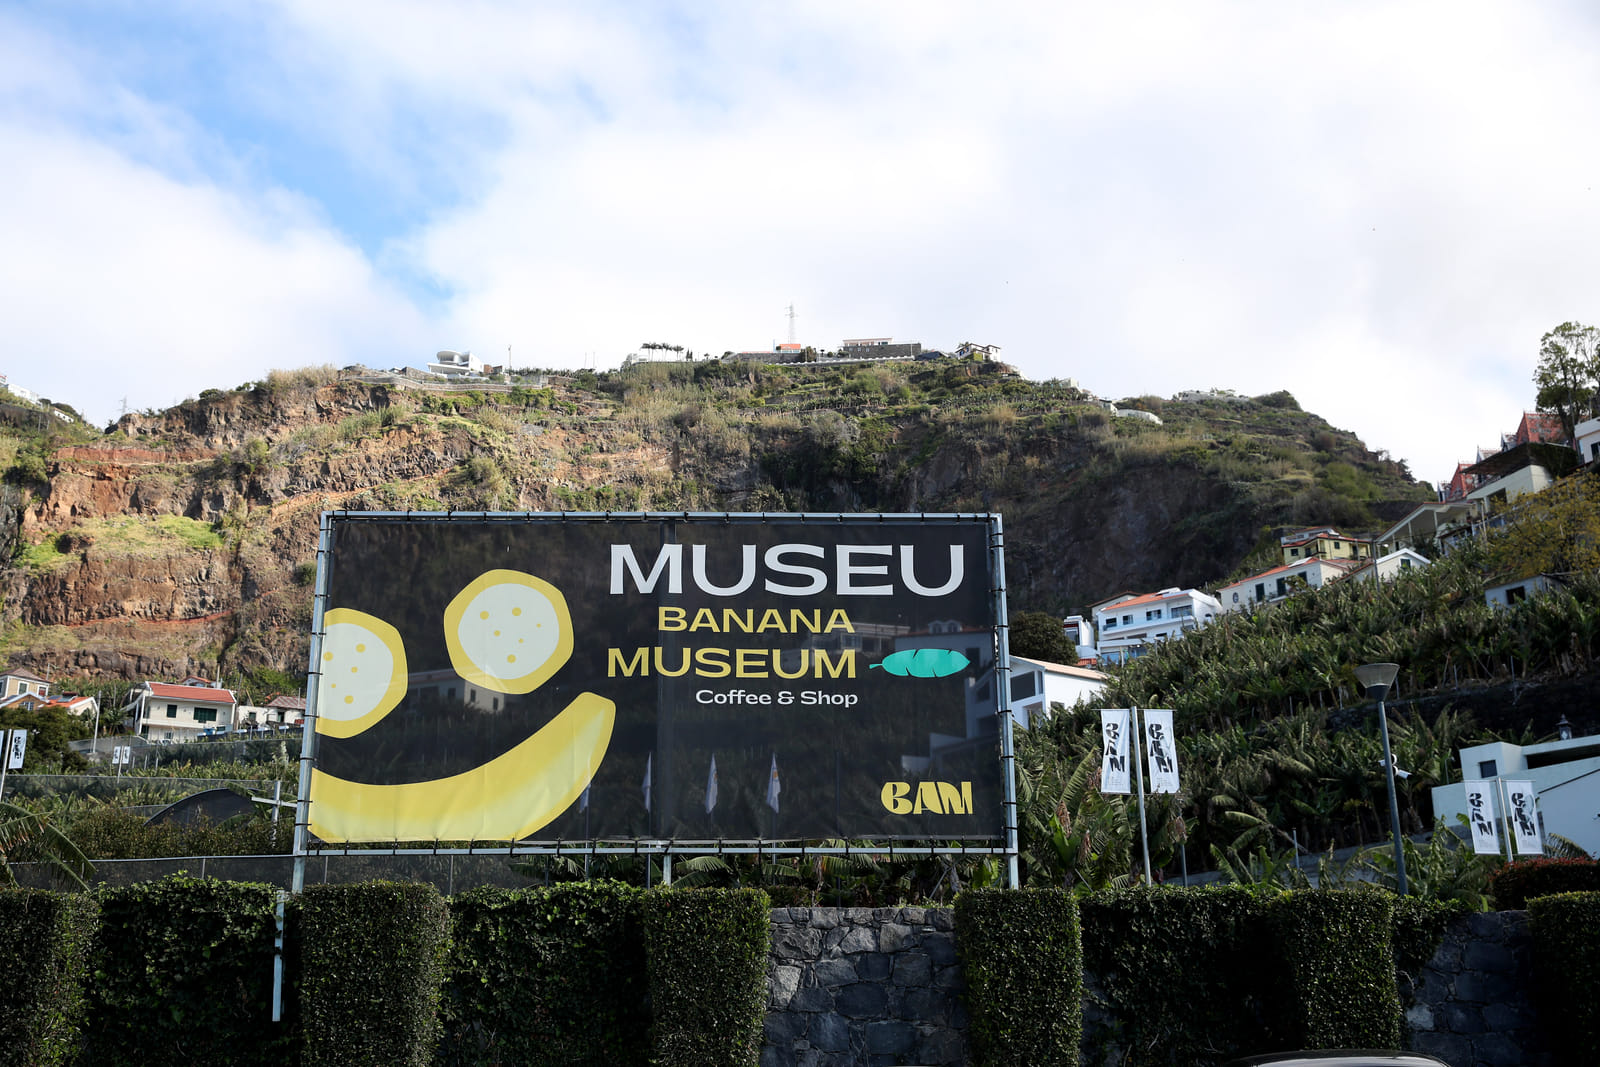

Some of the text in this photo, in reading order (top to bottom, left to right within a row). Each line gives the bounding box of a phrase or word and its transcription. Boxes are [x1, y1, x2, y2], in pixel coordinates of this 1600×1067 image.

[609, 543, 965, 597] MUSEU
[658, 606, 856, 634] BANANA
[607, 646, 856, 679] MUSEUM
[695, 689, 858, 708] Coffee & Shop
